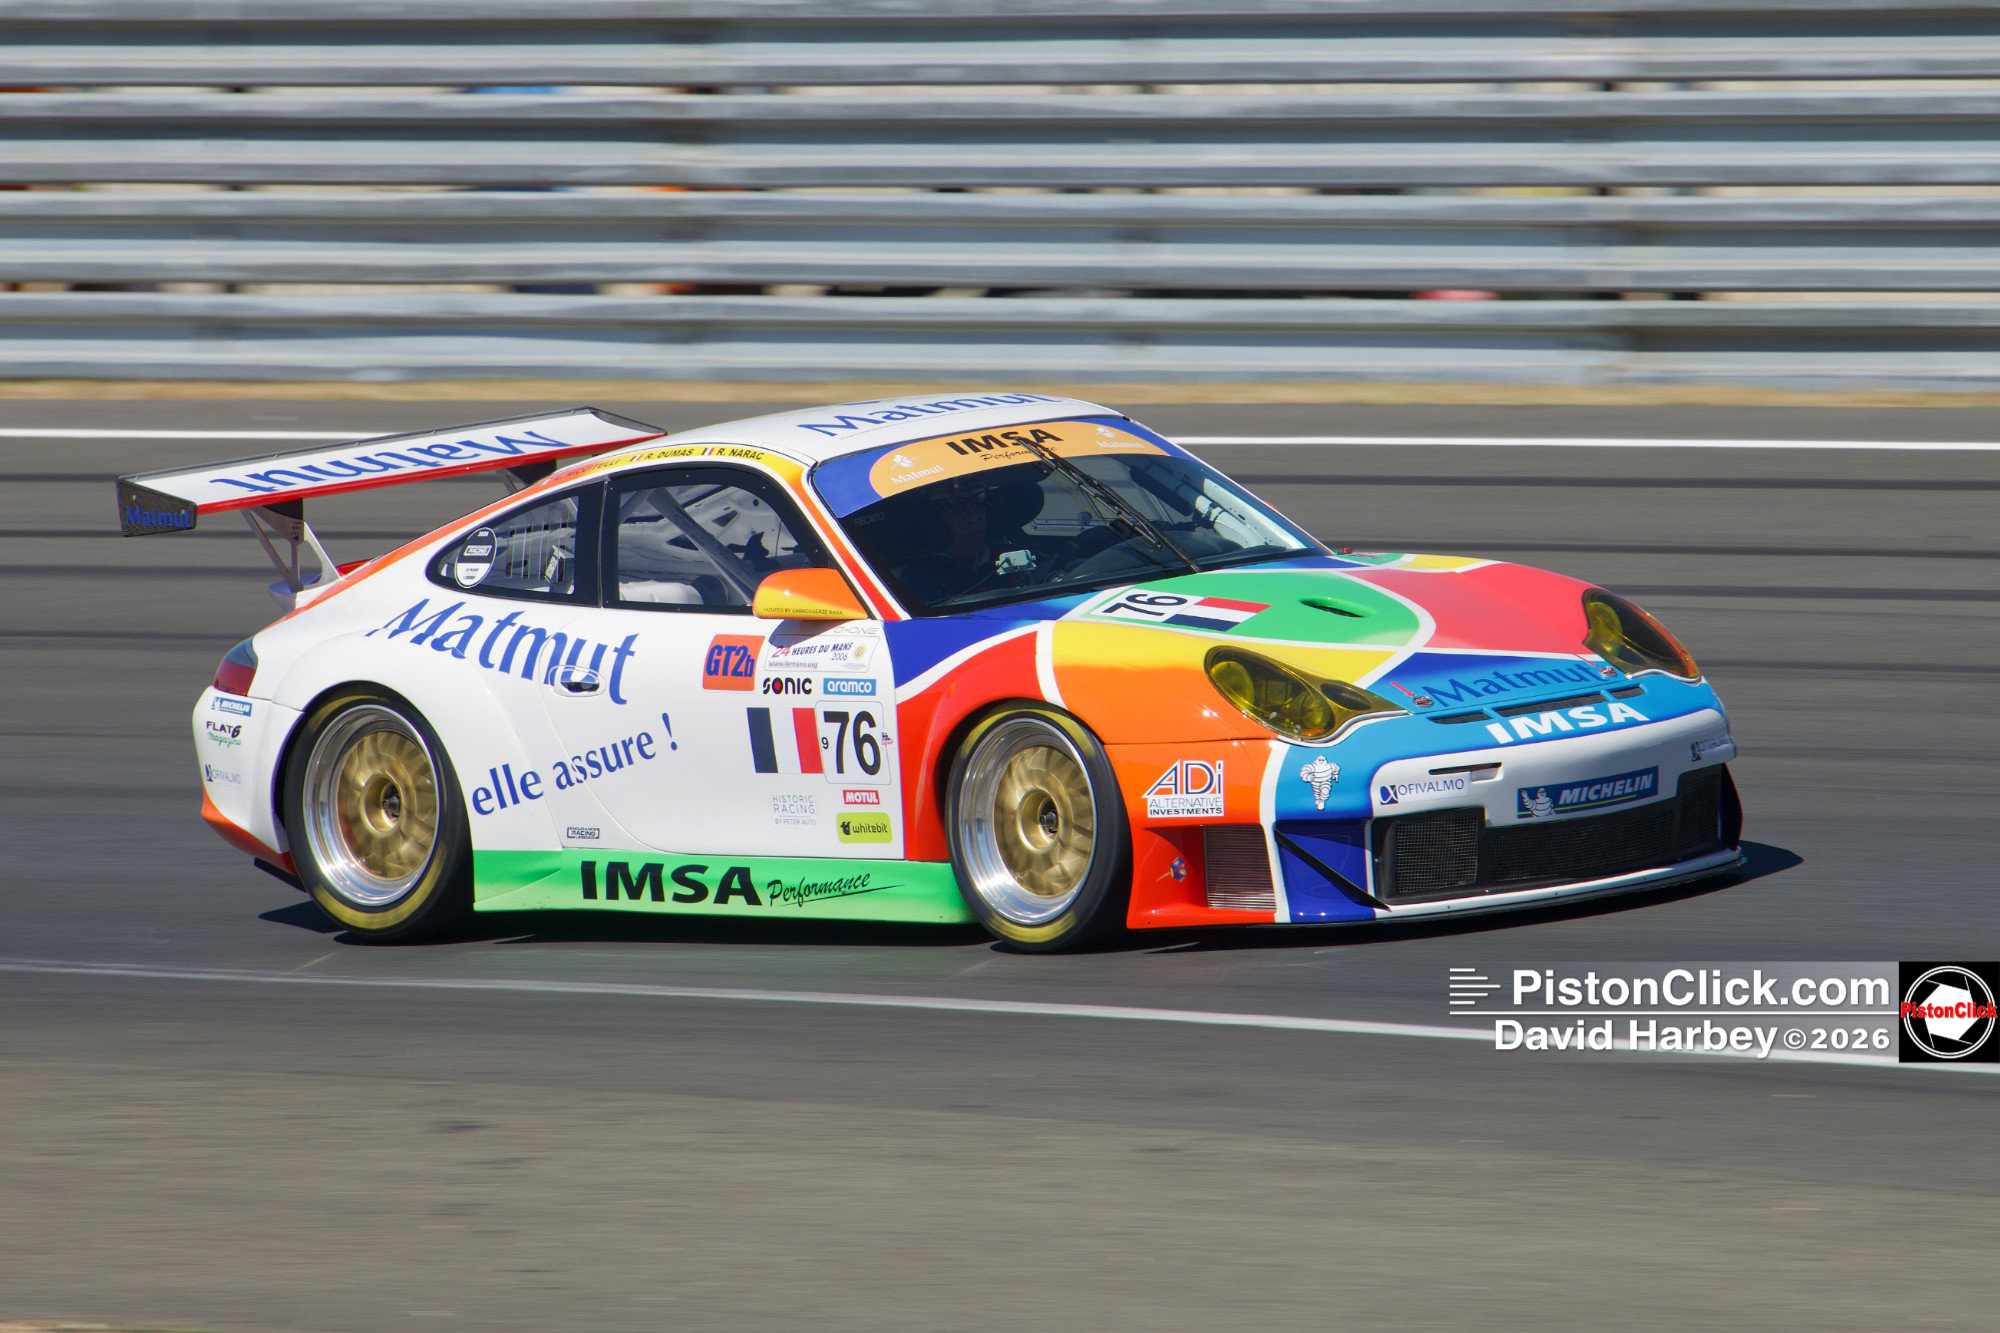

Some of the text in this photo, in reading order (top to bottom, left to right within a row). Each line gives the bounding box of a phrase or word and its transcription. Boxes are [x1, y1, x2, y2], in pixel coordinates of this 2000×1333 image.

[797, 393, 1062, 437] Matmut
[946, 428, 1065, 456] IMSA
[1096, 440, 1146, 449] Matmut
[658, 448, 694, 458] DUMAS
[716, 447, 765, 460] R. NARAC
[210, 431, 573, 494] Matmut
[890, 464, 946, 485] Matmut
[126, 505, 192, 528] Matmut
[1103, 593, 1188, 617] 76
[366, 598, 640, 704] Matmut
[772, 642, 853, 658] 24 HEURES DU MANS
[831, 652, 848, 661] 2006
[706, 644, 755, 678] GT2b
[827, 681, 872, 694] aramco
[1422, 663, 1601, 708] Matmut
[221, 700, 251, 713] MICHELIN
[1486, 702, 1650, 744] IMSA
[821, 737, 829, 749] 9
[823, 711, 882, 776] 76
[472, 712, 678, 816] elle assure !
[1398, 778, 1465, 796] OFIVALMO
[1559, 773, 1654, 806] MICHELIN
[772, 795, 814, 804] HISTORIC
[845, 792, 878, 803] MOTUL
[1150, 797, 1222, 808] ALTERNATIVE
[773, 804, 816, 814] RACING
[1150, 807, 1222, 816] INVESTMENTS
[803, 818, 817, 826] AUTO
[852, 823, 888, 834] whitebit
[581, 860, 762, 907] IMSA
[767, 873, 870, 907] Performance
